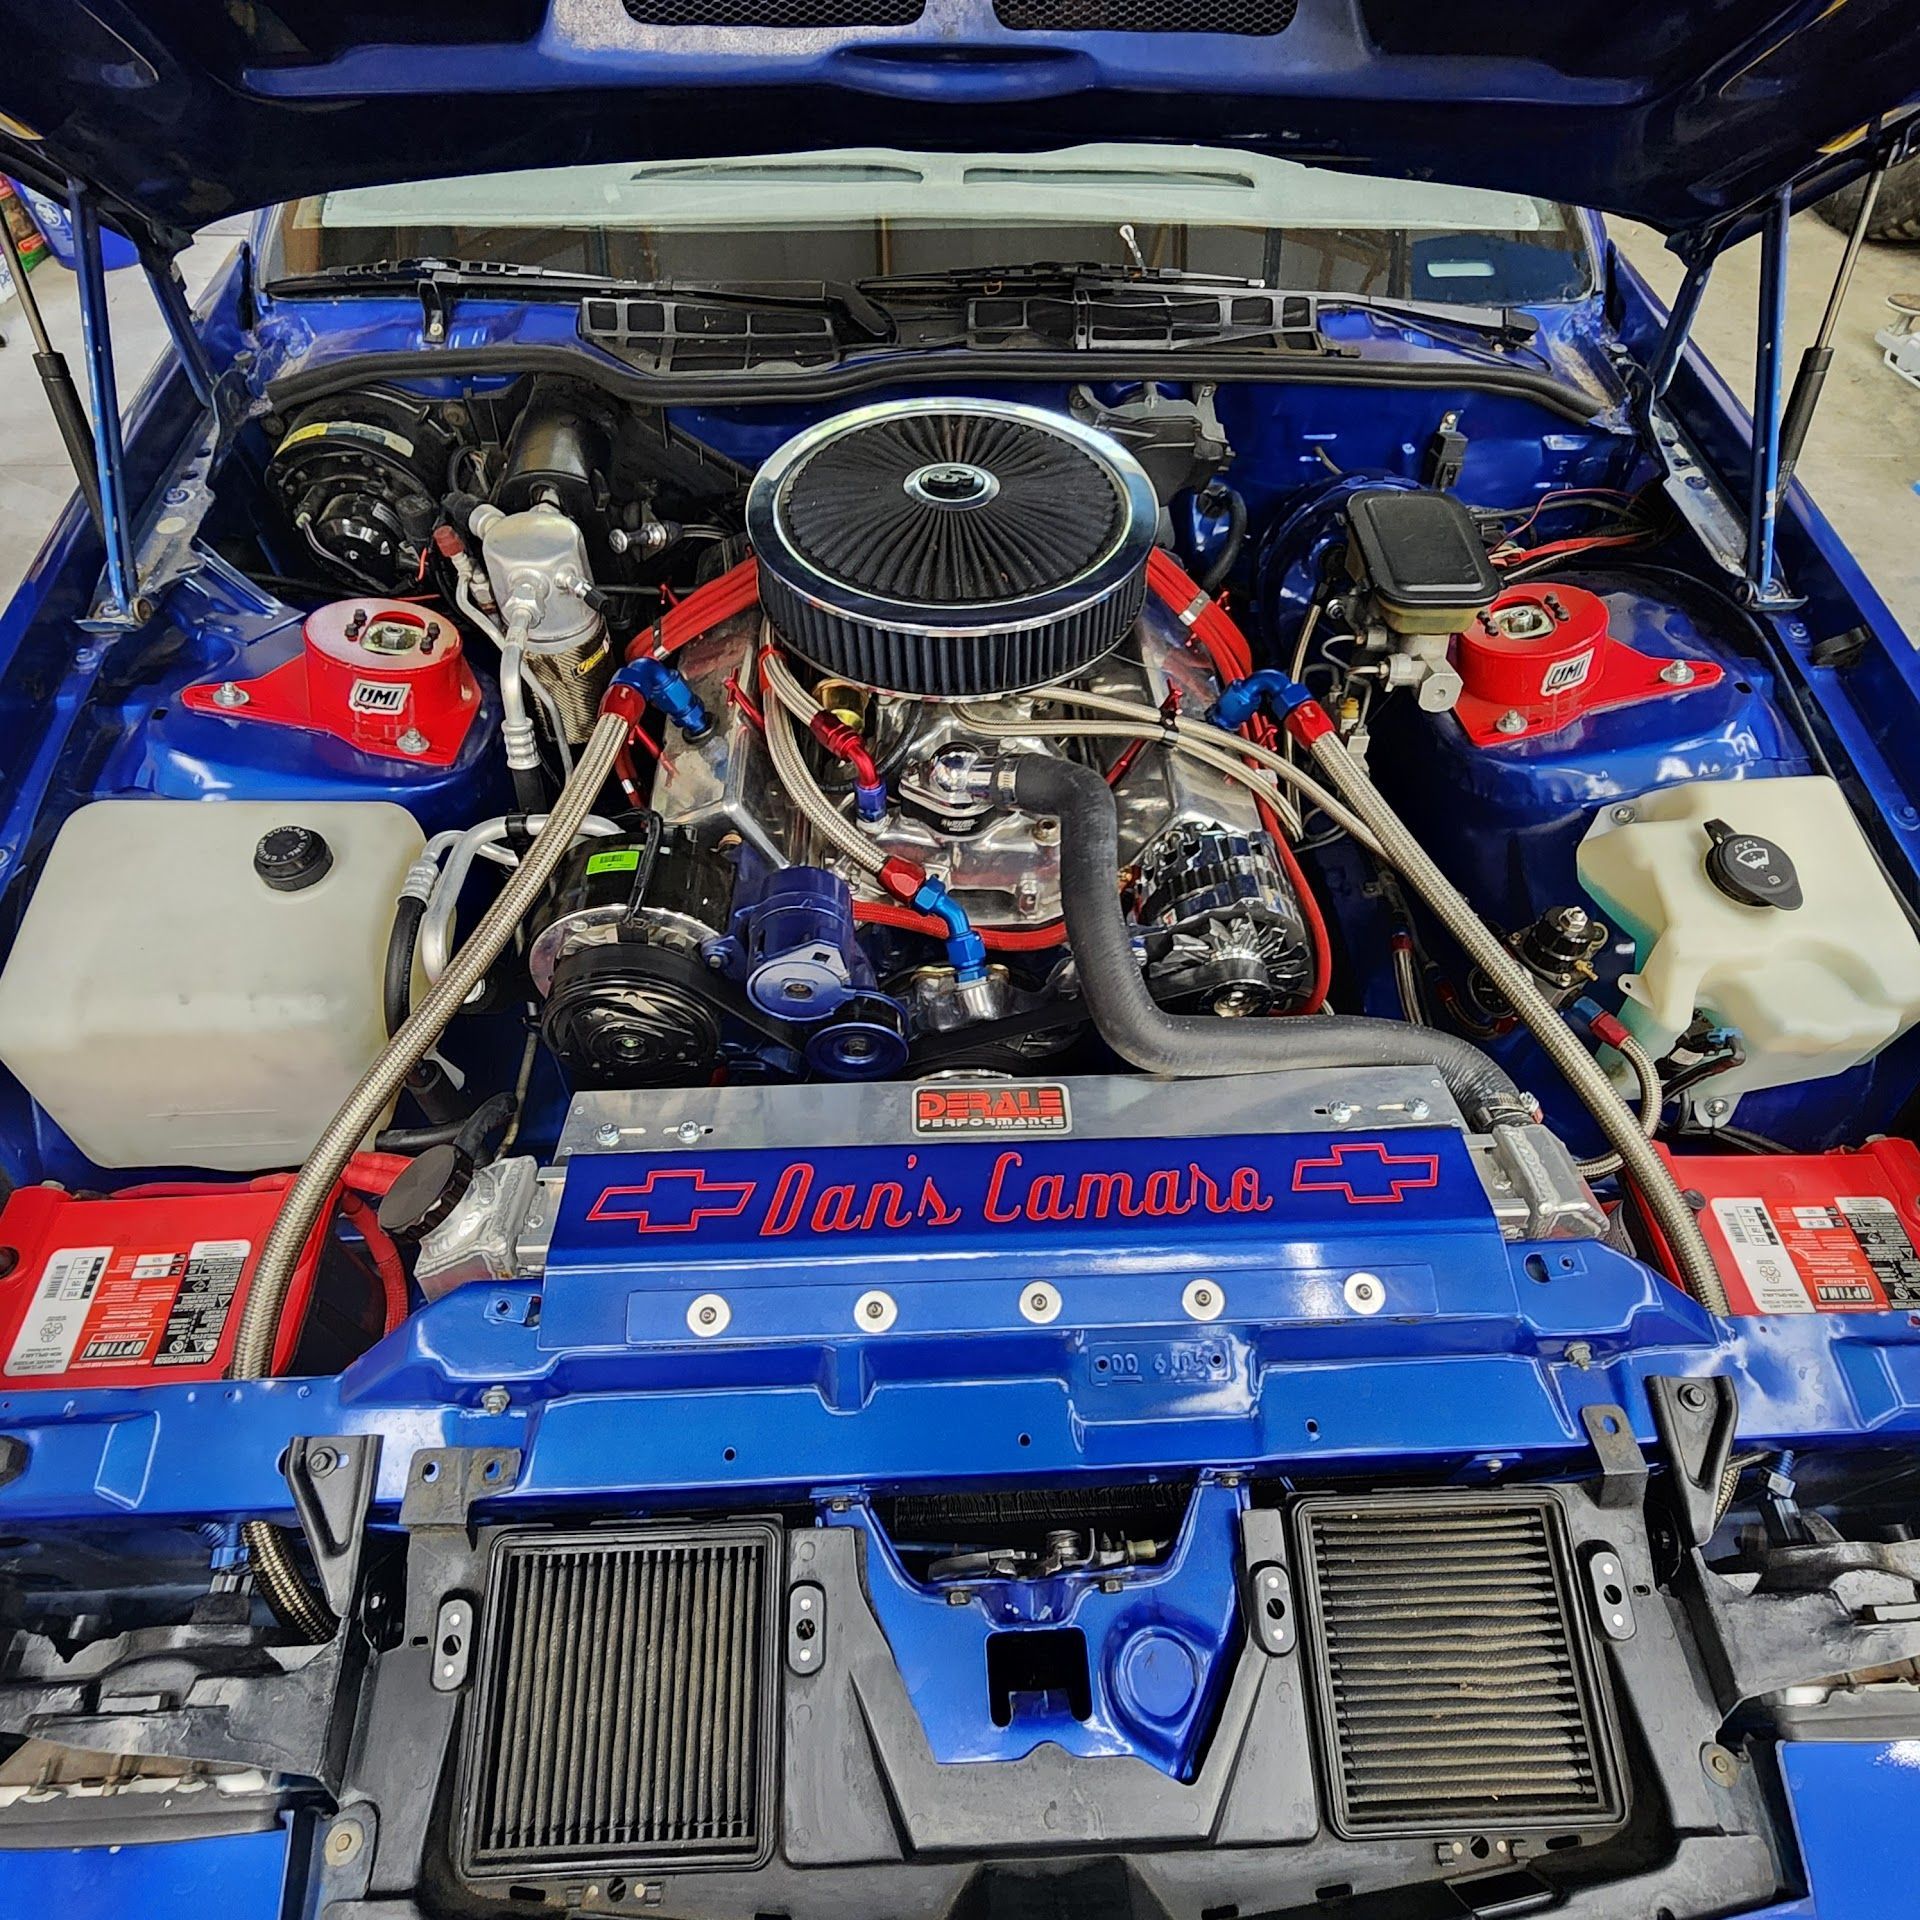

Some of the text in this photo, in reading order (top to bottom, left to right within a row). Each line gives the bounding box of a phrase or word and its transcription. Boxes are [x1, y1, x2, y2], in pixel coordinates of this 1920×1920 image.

[1550, 660, 1586, 685] UMI
[359, 687, 400, 706] UMI
[267, 826, 308, 841] COOLANT
[919, 1090, 1063, 1118] DERALE
[919, 1117, 1065, 1128] PERFORMANCE
[759, 1151, 1274, 1236] Dan's Camaro
[1818, 1286, 1870, 1299] OPTIMA
[82, 1340, 148, 1358] OPTIMA
